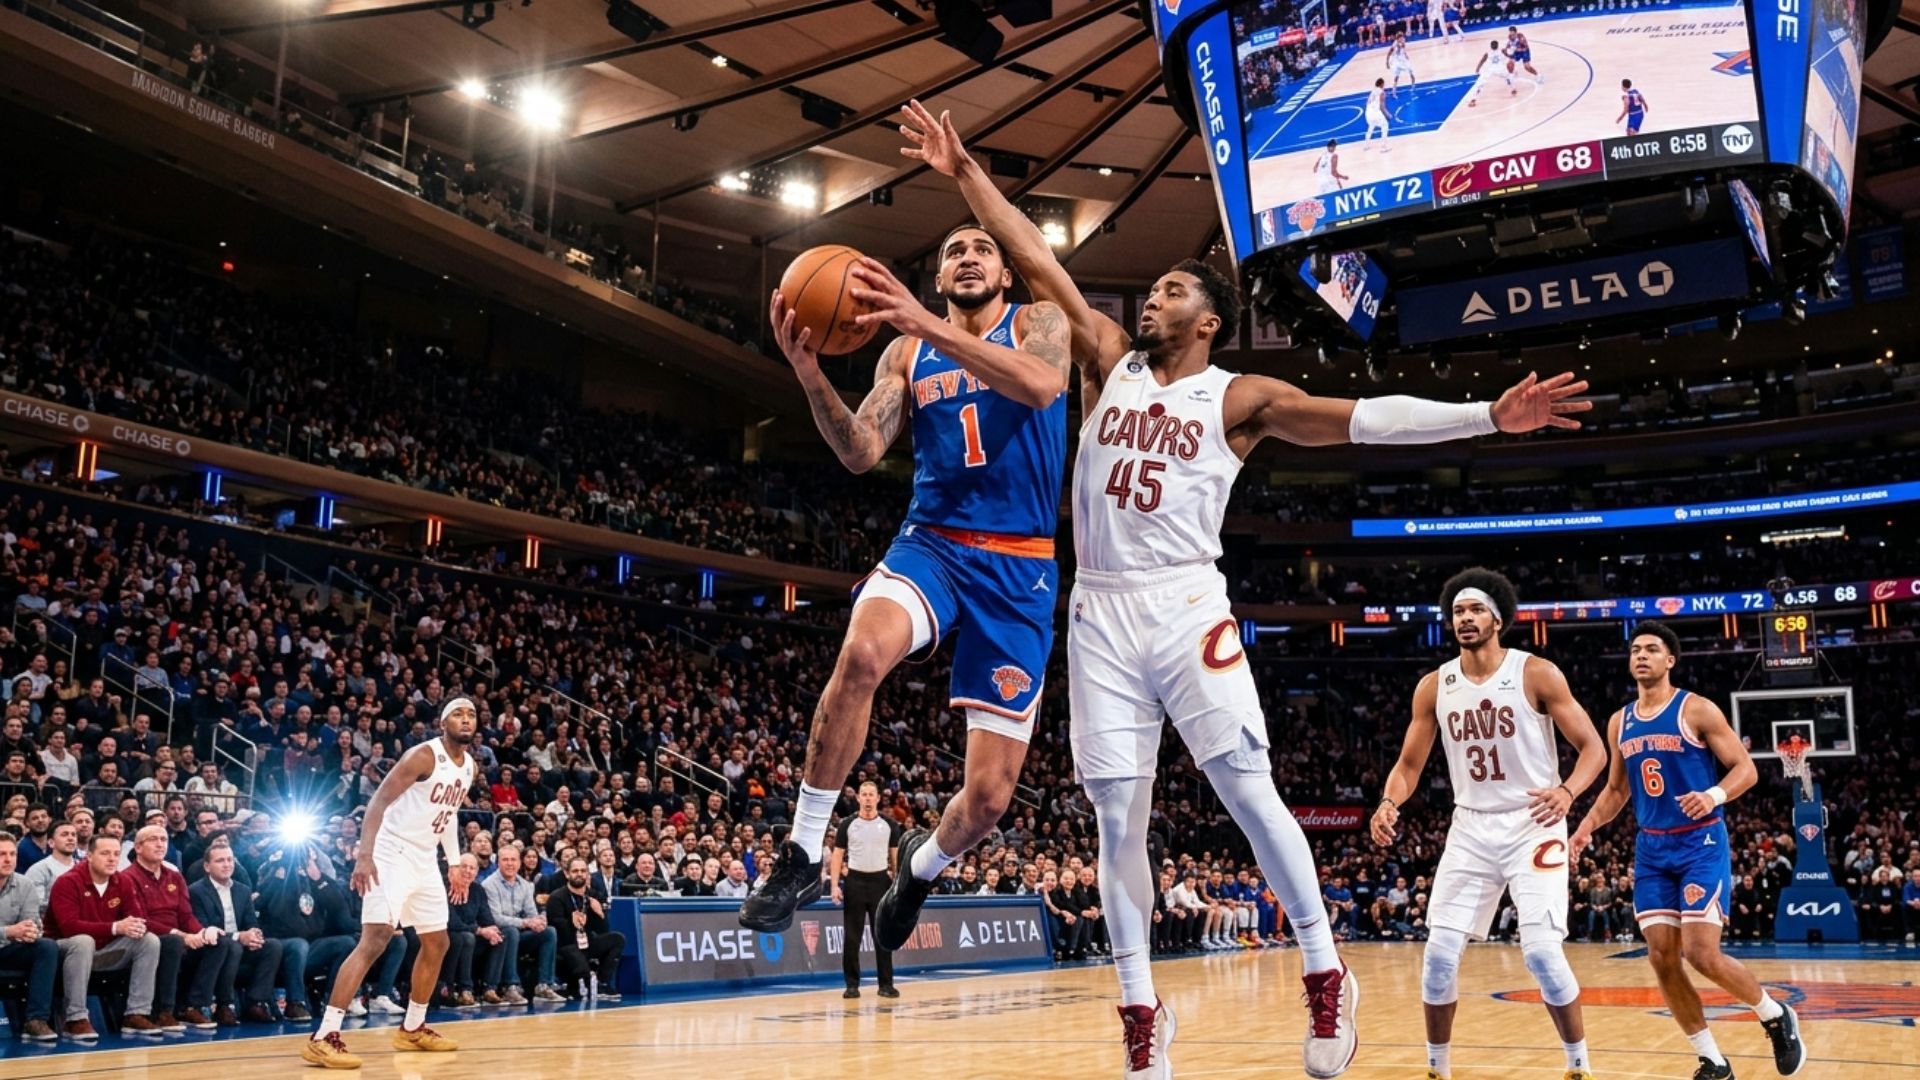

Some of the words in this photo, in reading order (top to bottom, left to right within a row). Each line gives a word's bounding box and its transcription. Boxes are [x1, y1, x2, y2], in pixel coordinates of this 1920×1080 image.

[1196, 42, 1225, 137] CHASE
[1611, 144, 1632, 161] 4th
[1722, 131, 1753, 149] TNT
[1489, 155, 1537, 183] CAV
[1556, 146, 1592, 172] 68
[1334, 187, 1378, 215] NYK
[1392, 177, 1423, 201] 72
[4, 399, 69, 428] CHASE
[112, 425, 173, 451] CHASE
[959, 403, 987, 468] 1
[1104, 458, 1167, 513] 45
[1692, 597, 1727, 611] NYK
[1742, 594, 1764, 608] 72
[1834, 586, 1857, 602] 68
[1447, 698, 1516, 742] CAVS
[1466, 744, 1506, 782] 31
[1641, 758, 1664, 797] 6
[655, 929, 755, 963] CHASE
[977, 920, 1041, 945] DELTA
